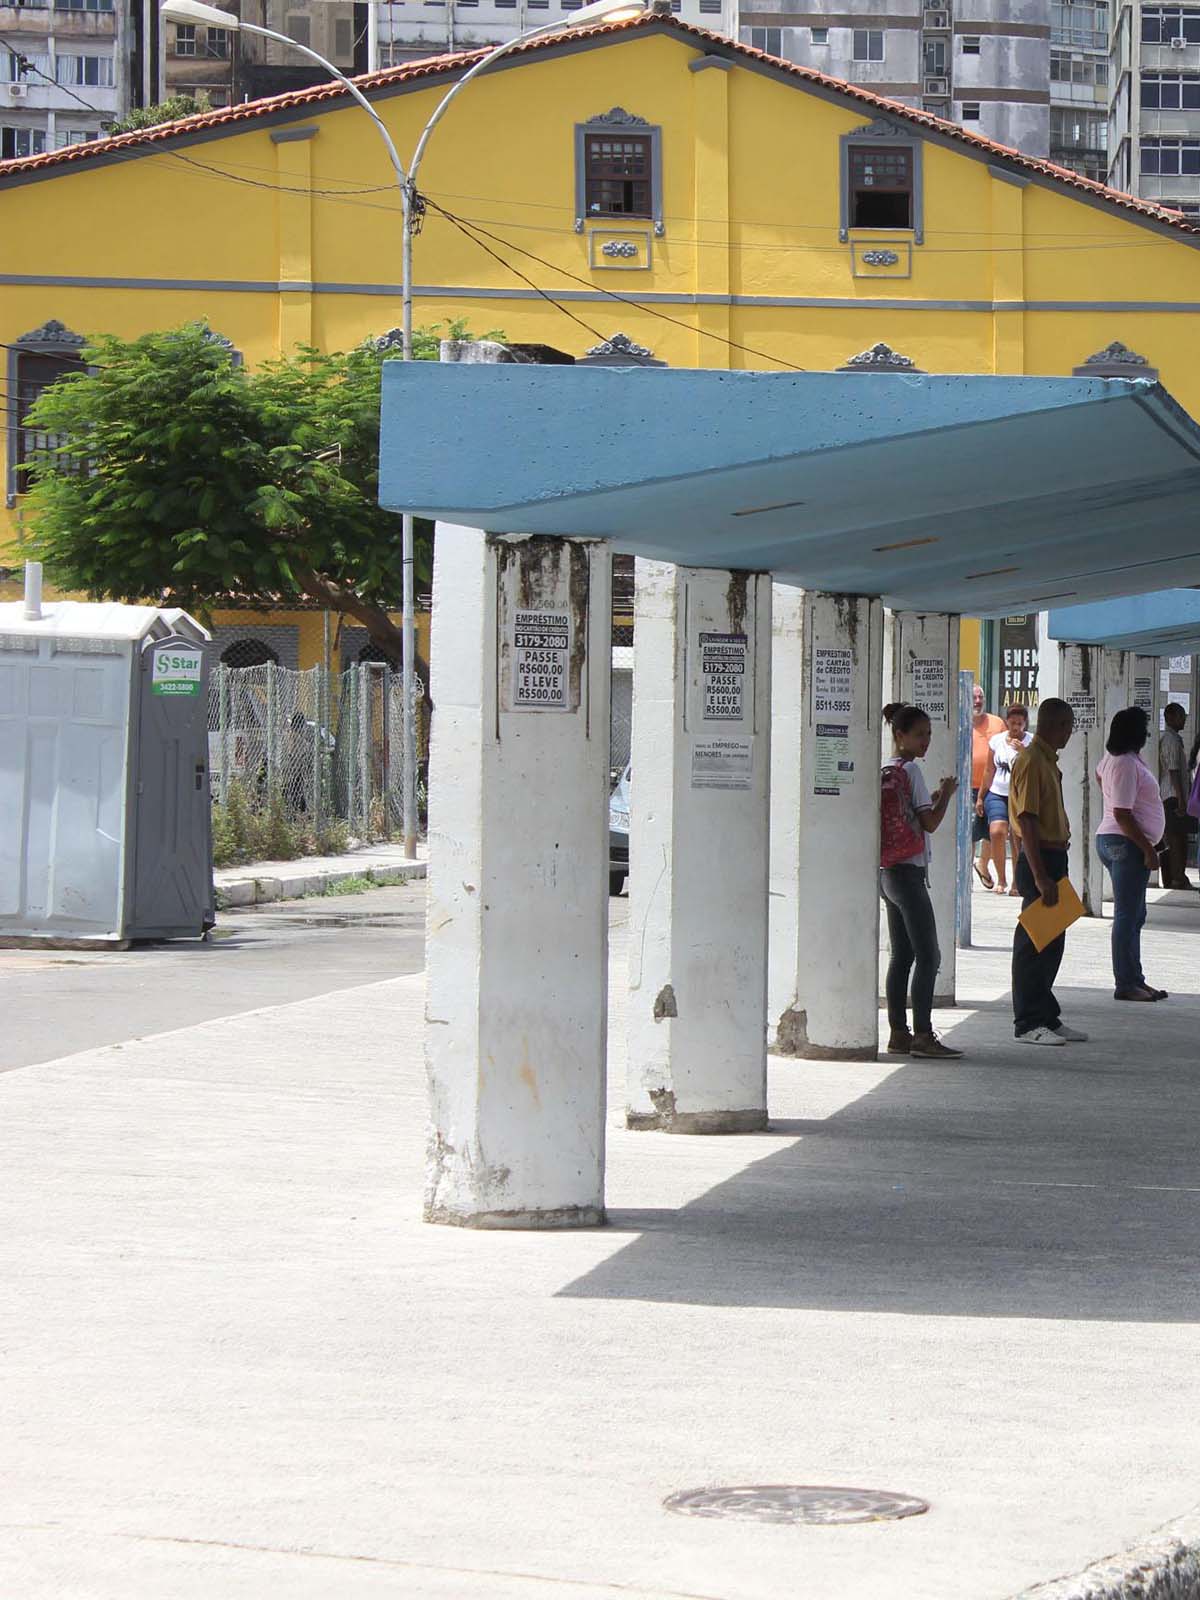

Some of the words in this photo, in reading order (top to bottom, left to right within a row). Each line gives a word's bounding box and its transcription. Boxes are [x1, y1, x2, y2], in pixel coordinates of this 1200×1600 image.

[515, 613, 568, 624] EMPRÉSTIMO
[516, 635, 566, 648] 3179-2080
[171, 657, 198, 669] Star
[525, 651, 558, 663] PASSE
[519, 663, 563, 675] R$600,00
[704, 663, 743, 673] 3179-2080
[523, 676, 529, 687] E
[532, 676, 558, 688] LEVE
[711, 676, 736, 685] PASSE
[1004, 670, 1021, 688] EU
[518, 687, 562, 700] R$500,00
[710, 695, 714, 705] E
[717, 695, 737, 705] LEVE
[816, 700, 850, 711] 8511-5955
